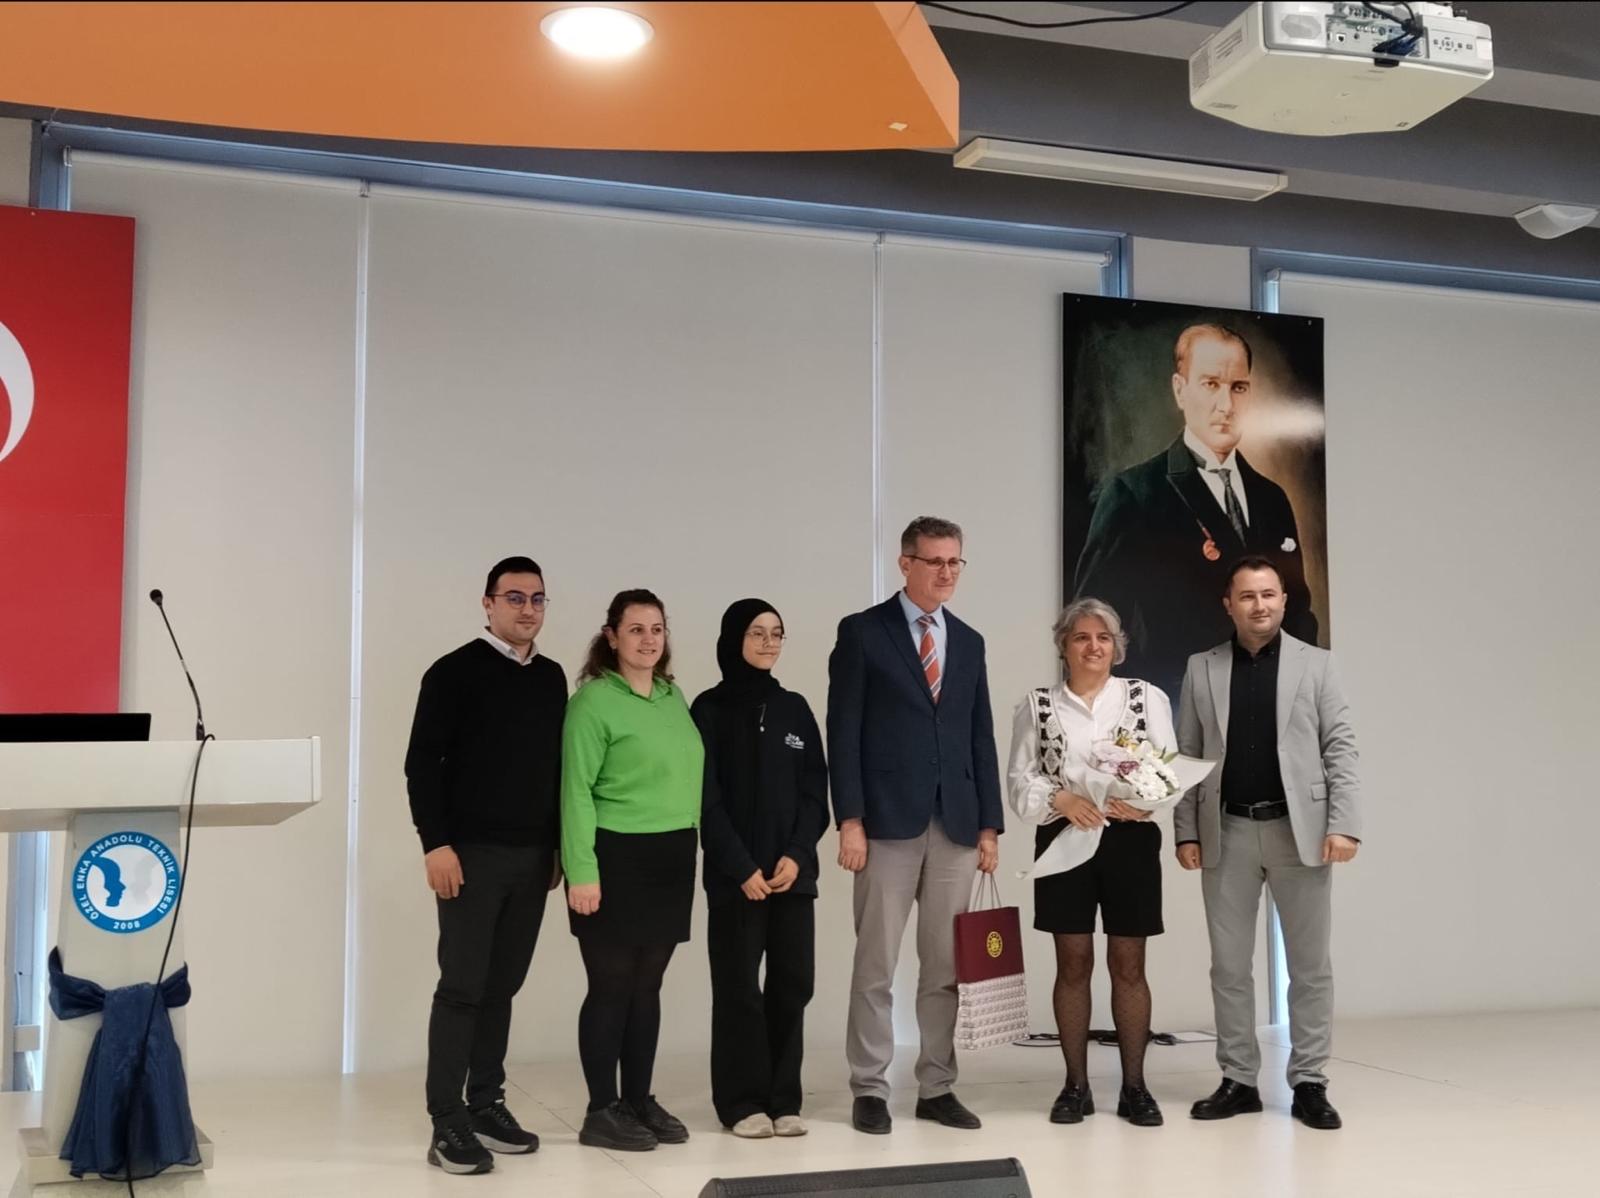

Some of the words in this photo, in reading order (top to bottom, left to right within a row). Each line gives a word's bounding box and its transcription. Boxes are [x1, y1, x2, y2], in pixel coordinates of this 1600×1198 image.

[76, 860, 91, 889] ENKA
[90, 835, 143, 857] ANADOLU
[147, 840, 175, 874] TEKNİK
[113, 920, 141, 930] 2008
